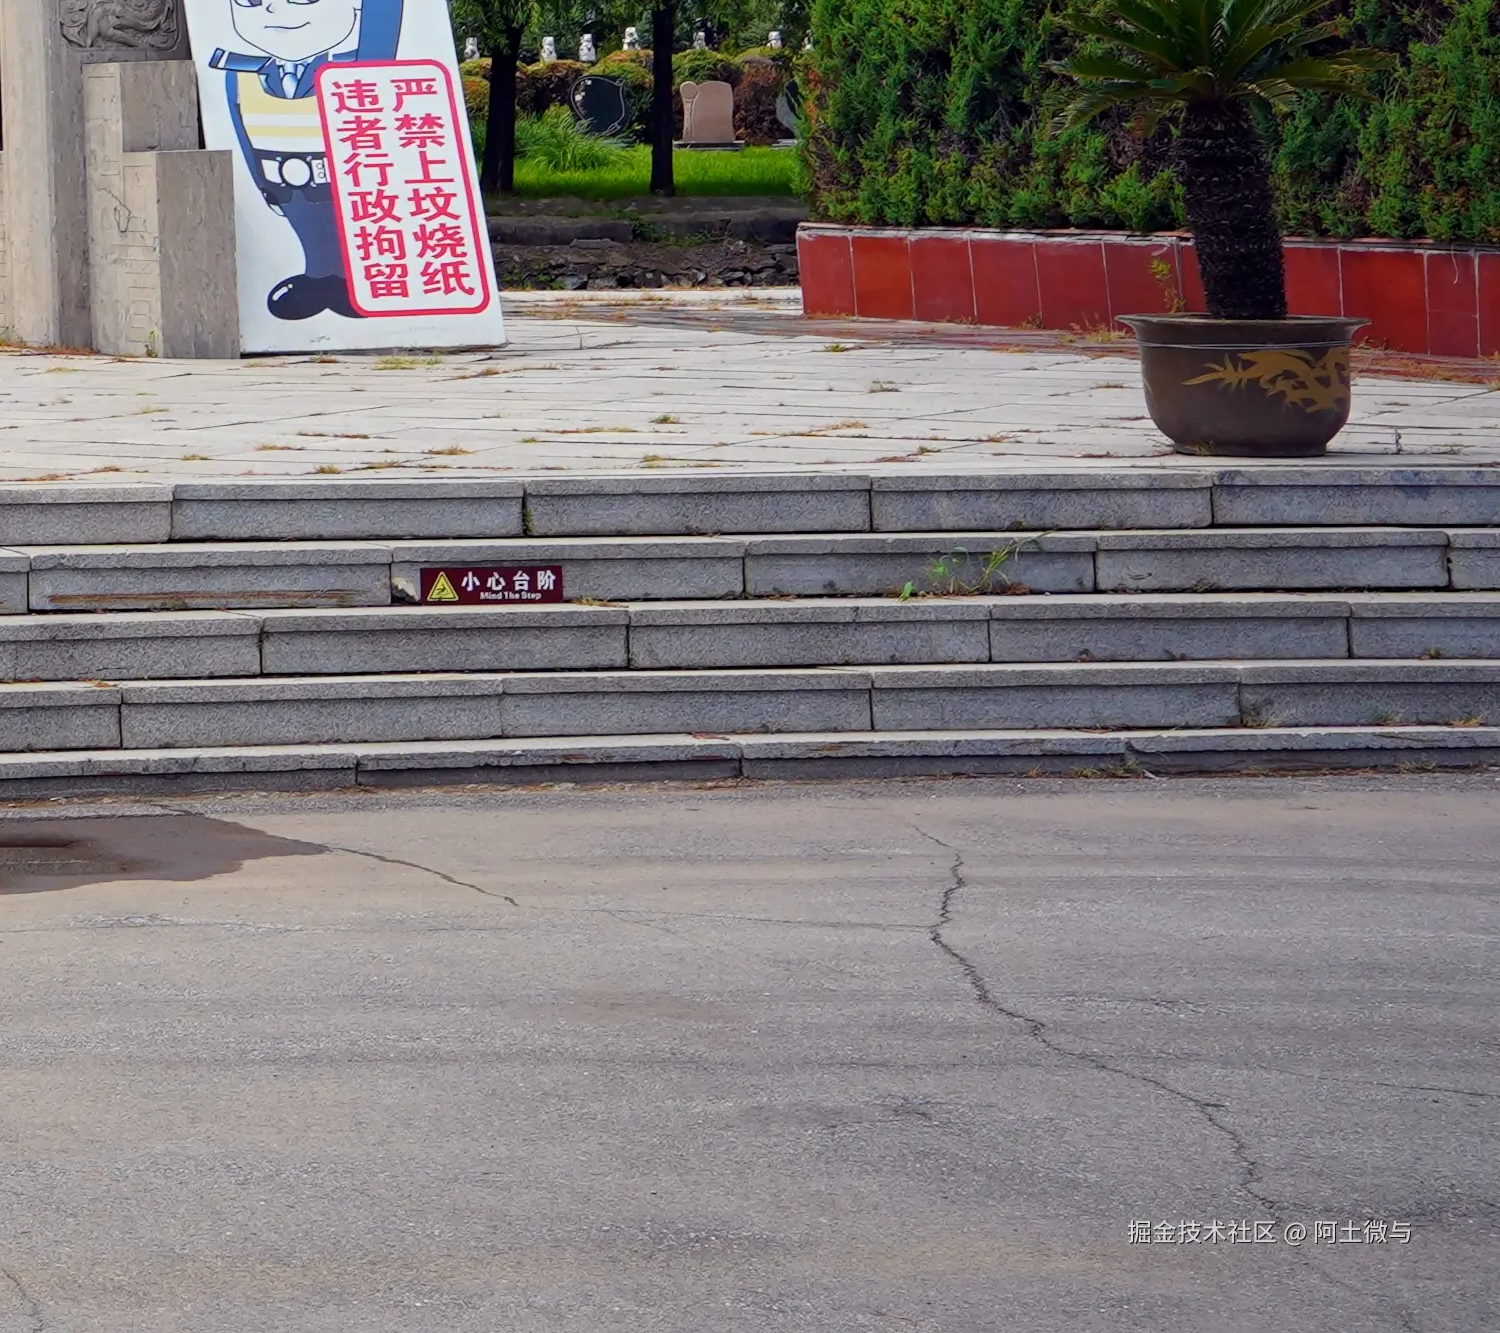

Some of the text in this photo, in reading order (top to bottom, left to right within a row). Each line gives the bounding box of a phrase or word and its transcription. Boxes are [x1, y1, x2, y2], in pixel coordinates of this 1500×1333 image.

[330, 79, 410, 299] 违者行政拘留
[390, 77, 476, 297] 严禁上坟烧纸
[461, 570, 556, 591] 小心台阶
[480, 590, 542, 601] Mind The Step
